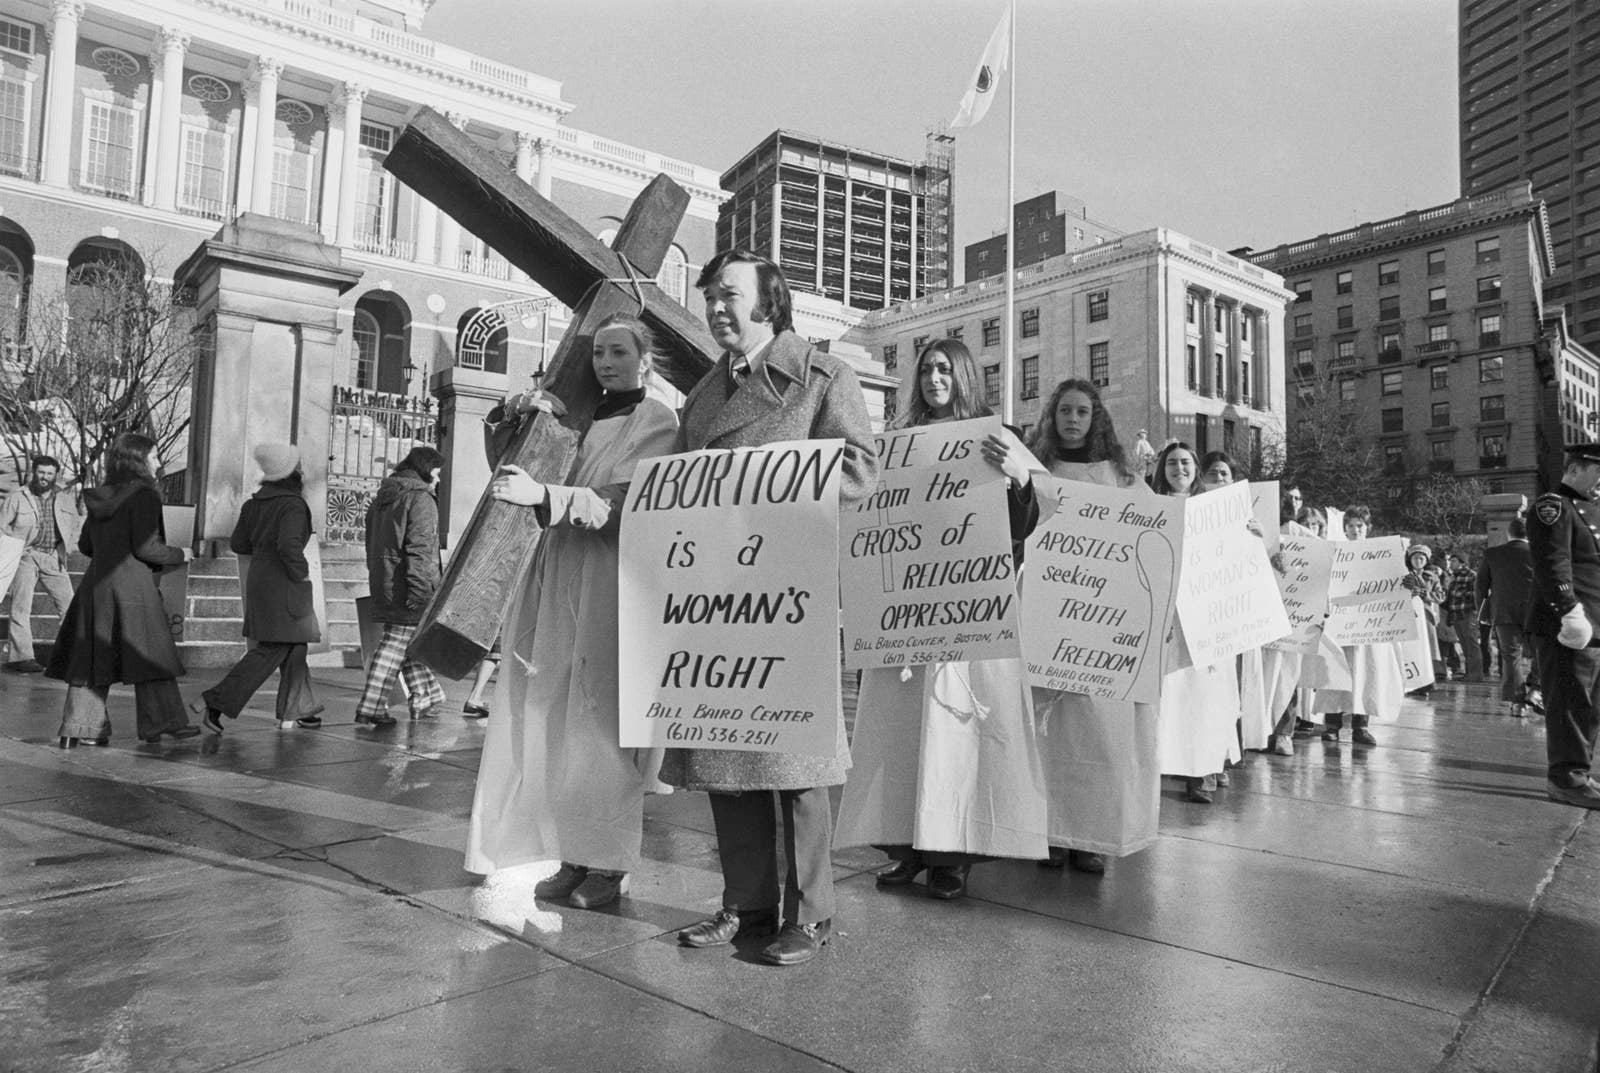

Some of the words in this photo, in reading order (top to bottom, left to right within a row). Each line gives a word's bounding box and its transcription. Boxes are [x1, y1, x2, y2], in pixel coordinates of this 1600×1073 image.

[937, 439, 975, 462] us
[631, 447, 844, 513] ABORTION
[925, 472, 970, 503] the
[1078, 502, 1110, 521] are
[1116, 502, 1168, 530] female
[665, 530, 697, 568] is
[737, 534, 764, 566] a
[850, 523, 922, 558] CROSS
[940, 513, 977, 546] of
[1036, 530, 1134, 563] APOSTLES
[1334, 548, 1355, 563] ho
[1361, 549, 1392, 561] owns
[902, 553, 1013, 591] RELIGIOUS
[1041, 565, 1108, 598] seeking
[663, 586, 810, 626] WOMAN'S
[880, 594, 1013, 632] OPPRESSION
[1058, 598, 1128, 627] TRUTH
[853, 638, 873, 652] BILL
[1112, 629, 1145, 648] and
[660, 650, 786, 690] RIGHT
[883, 651, 905, 665] (617)
[910, 650, 964, 664] 536-2511
[1052, 637, 1138, 674] FREEDOM
[1045, 665, 1077, 681] BAIRD
[1077, 672, 1114, 686] CENTER
[645, 701, 683, 720] BILL
[692, 703, 744, 720] BAIRD
[750, 705, 815, 723] CENTER
[666, 722, 703, 742] (617)
[707, 726, 780, 747] 536-2511
